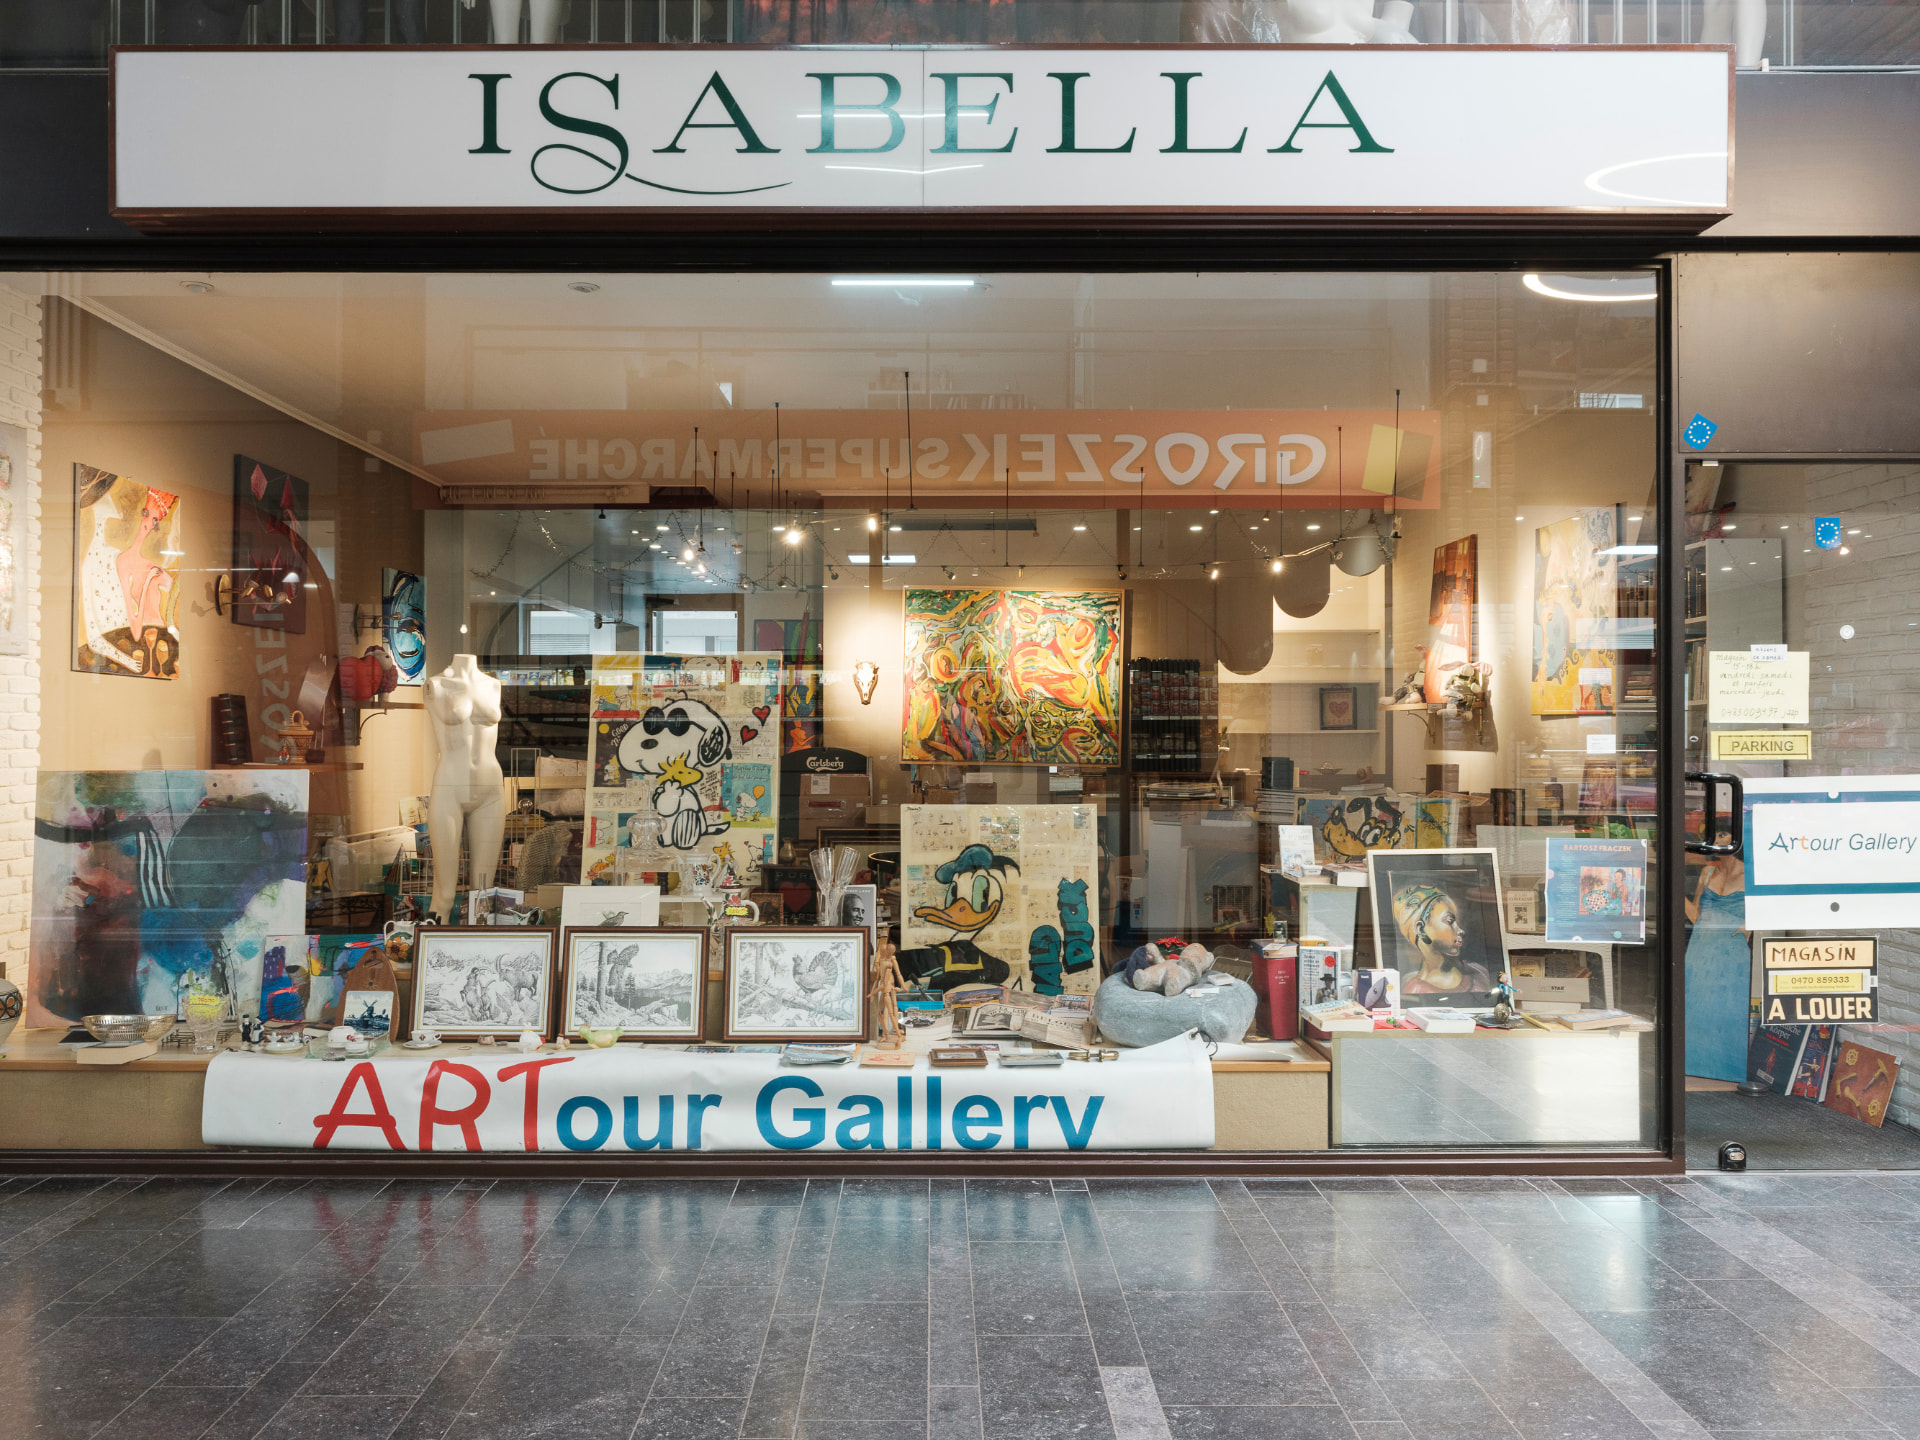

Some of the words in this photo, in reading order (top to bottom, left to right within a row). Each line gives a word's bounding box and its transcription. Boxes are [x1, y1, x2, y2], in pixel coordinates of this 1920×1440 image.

[467, 69, 1396, 195] ISABELLA
[1731, 740, 1794, 752] PARKING
[806, 756, 845, 771] Carlsberg
[1563, 844, 1598, 852] BARTOSZ
[1767, 831, 1843, 854] Artour
[1848, 832, 1918, 854] Gallery
[1058, 876, 1095, 975] DUCK
[1791, 976, 1814, 984] 0470
[1816, 976, 1850, 984] 859333
[1768, 998, 1786, 1020] A
[1795, 996, 1873, 1020] LOUER
[312, 1057, 723, 1152] ARTour
